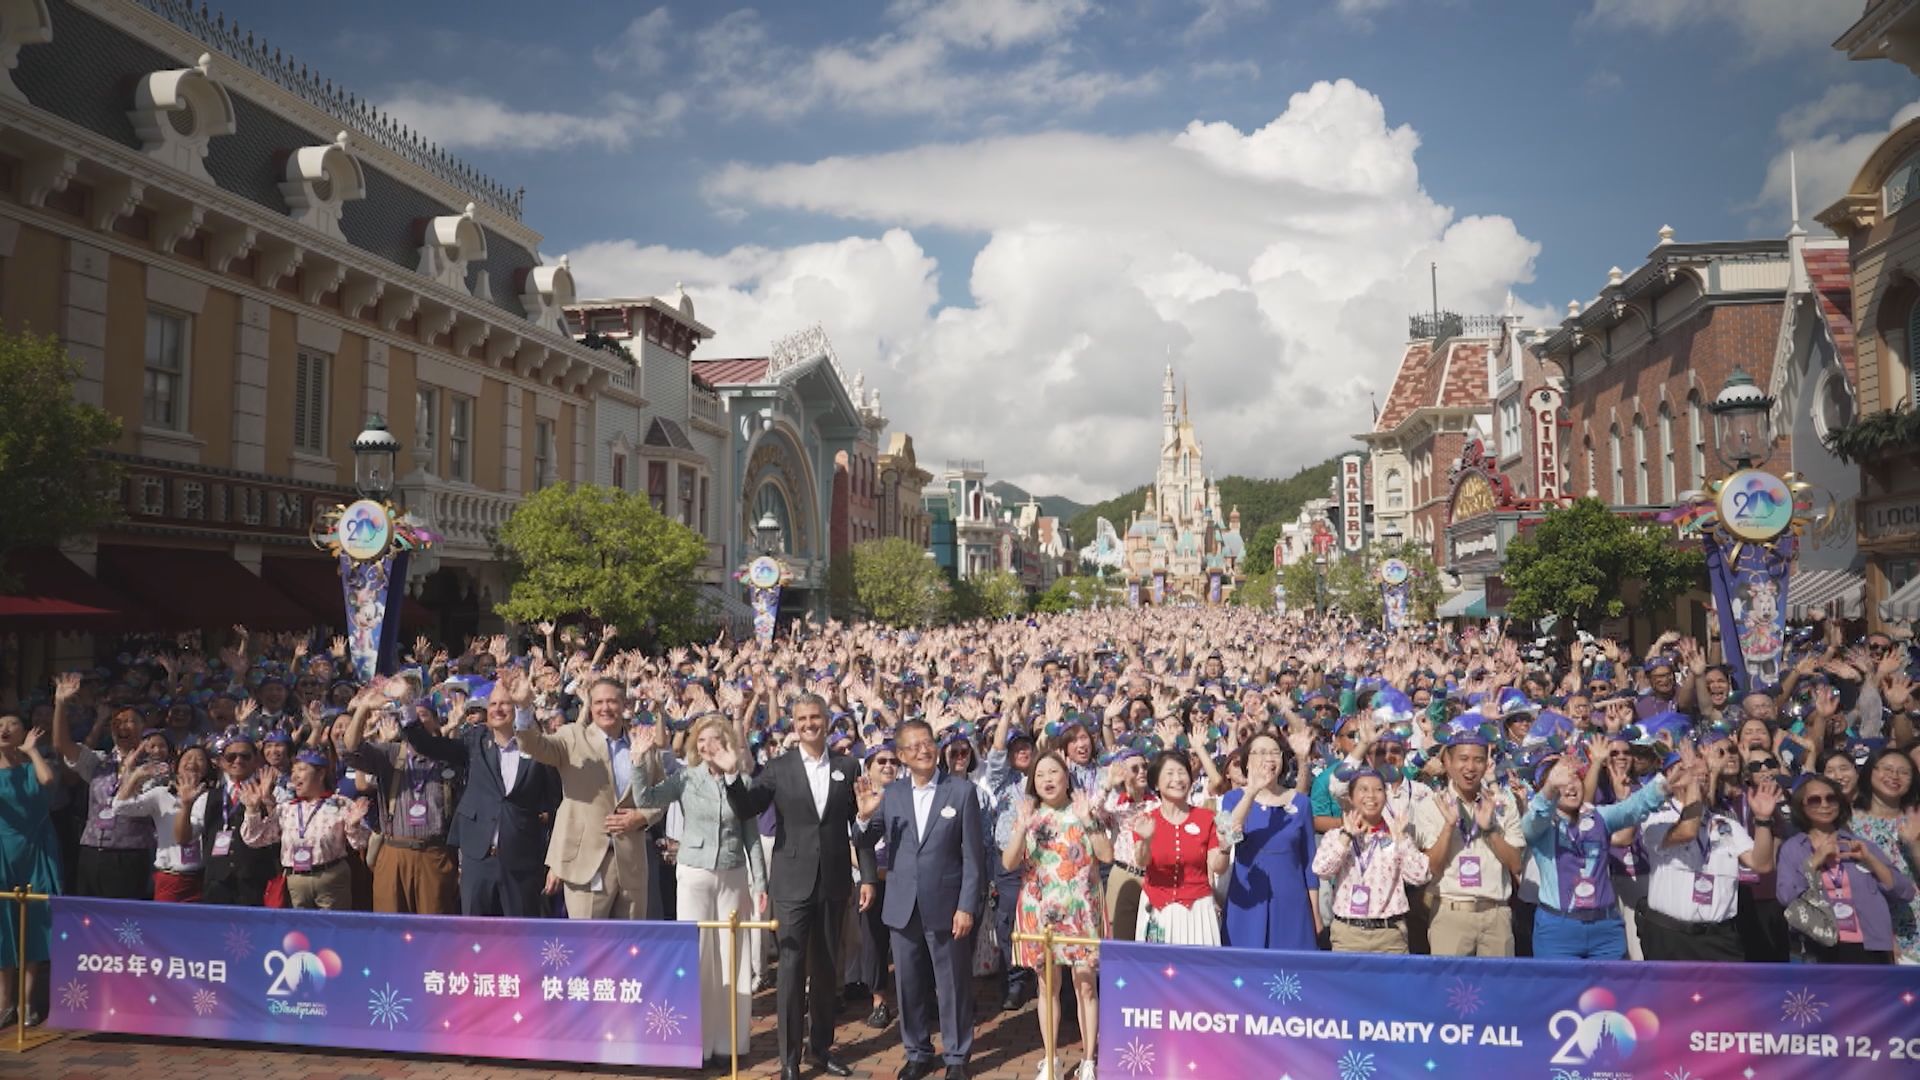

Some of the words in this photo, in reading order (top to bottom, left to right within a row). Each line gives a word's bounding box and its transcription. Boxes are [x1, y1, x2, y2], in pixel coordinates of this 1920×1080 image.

[1539, 409, 1557, 500] CINEMA
[1346, 462, 1361, 546] BAKERY
[423, 970, 521, 998] 奇妙派對
[541, 976, 643, 1003] 快樂盛放
[1121, 1007, 1163, 1030] THE
[1169, 1010, 1239, 1034] MOST
[1245, 1014, 1353, 1039] MAGICAL
[1359, 1019, 1434, 1044] PARTY
[1439, 1024, 1475, 1046] OF
[1479, 1025, 1523, 1047] ALL
[1689, 1030, 1839, 1058] SEPTEMBER
[1845, 1035, 1881, 1062] 12,
